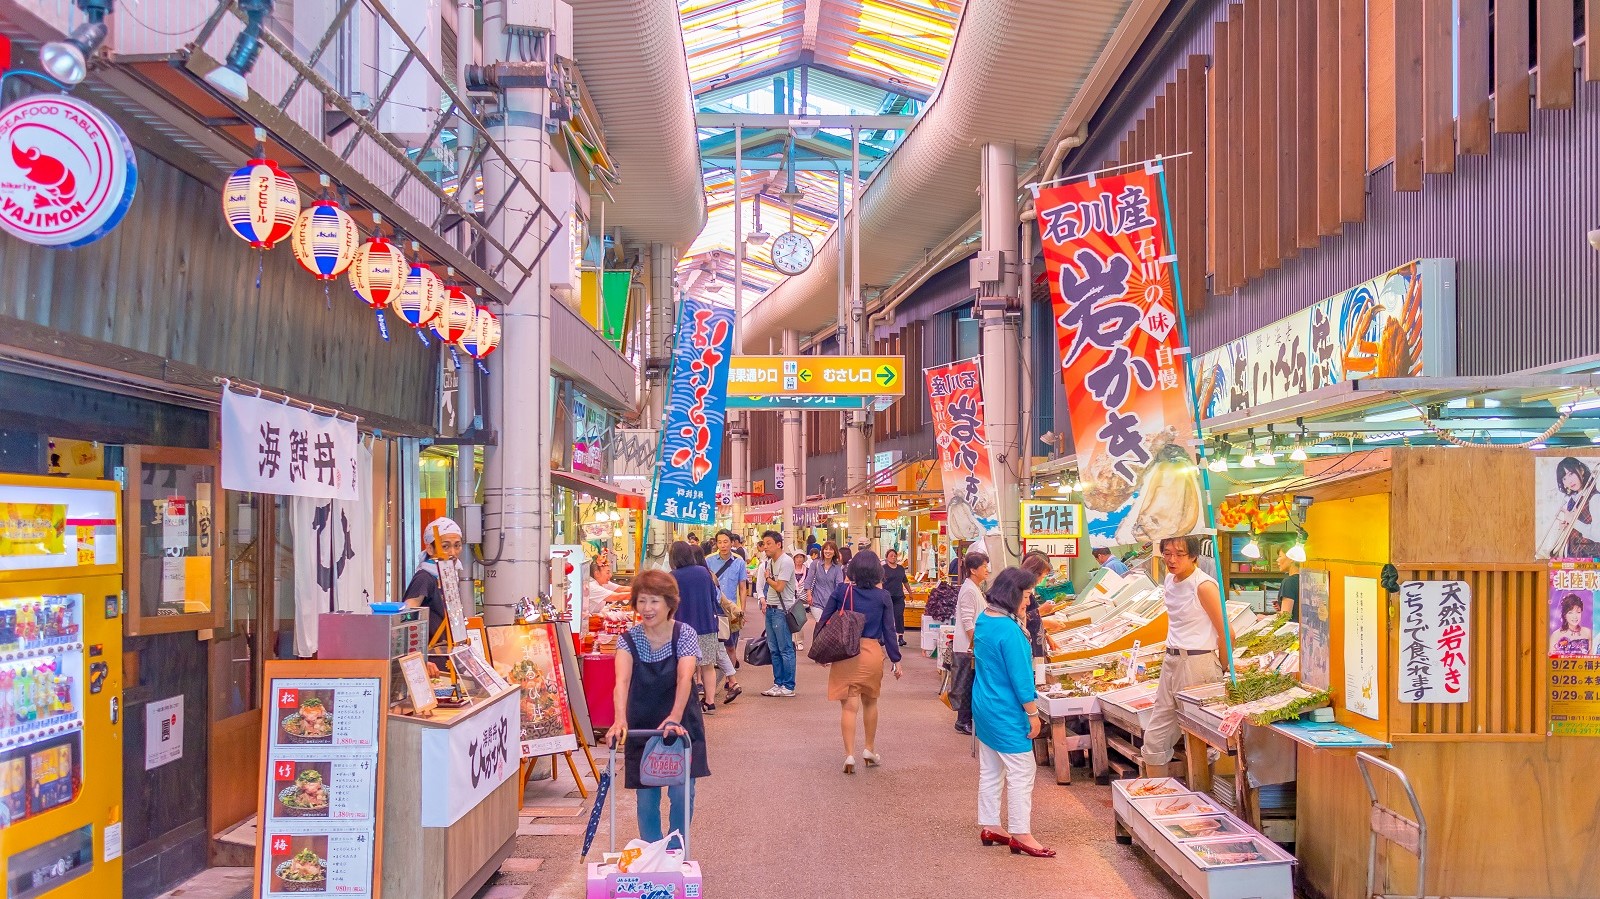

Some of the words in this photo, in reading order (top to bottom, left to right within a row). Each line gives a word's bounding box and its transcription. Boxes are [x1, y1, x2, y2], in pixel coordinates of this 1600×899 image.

[0, 106, 59, 135] SEAFOOD
[64, 110, 98, 139] TABLE
[257, 176, 269, 223] アサヒビール
[1041, 185, 1157, 245] 石川産
[823, 368, 872, 383] むさし口
[1058, 248, 1157, 486] 岩かき
[259, 421, 335, 487] 海鮮丼
[1029, 504, 1073, 531] 岩ガキ
[1402, 582, 1433, 701] こちらで食べれます
[1437, 582, 1467, 694] 天然岩かき
[1551, 660, 1577, 670] 9/27
[1551, 675, 1577, 685] 9/28
[281, 692, 295, 704] 松
[1551, 690, 1577, 700] 9/29
[278, 764, 292, 777] 竹
[274, 838, 289, 851] 梅
